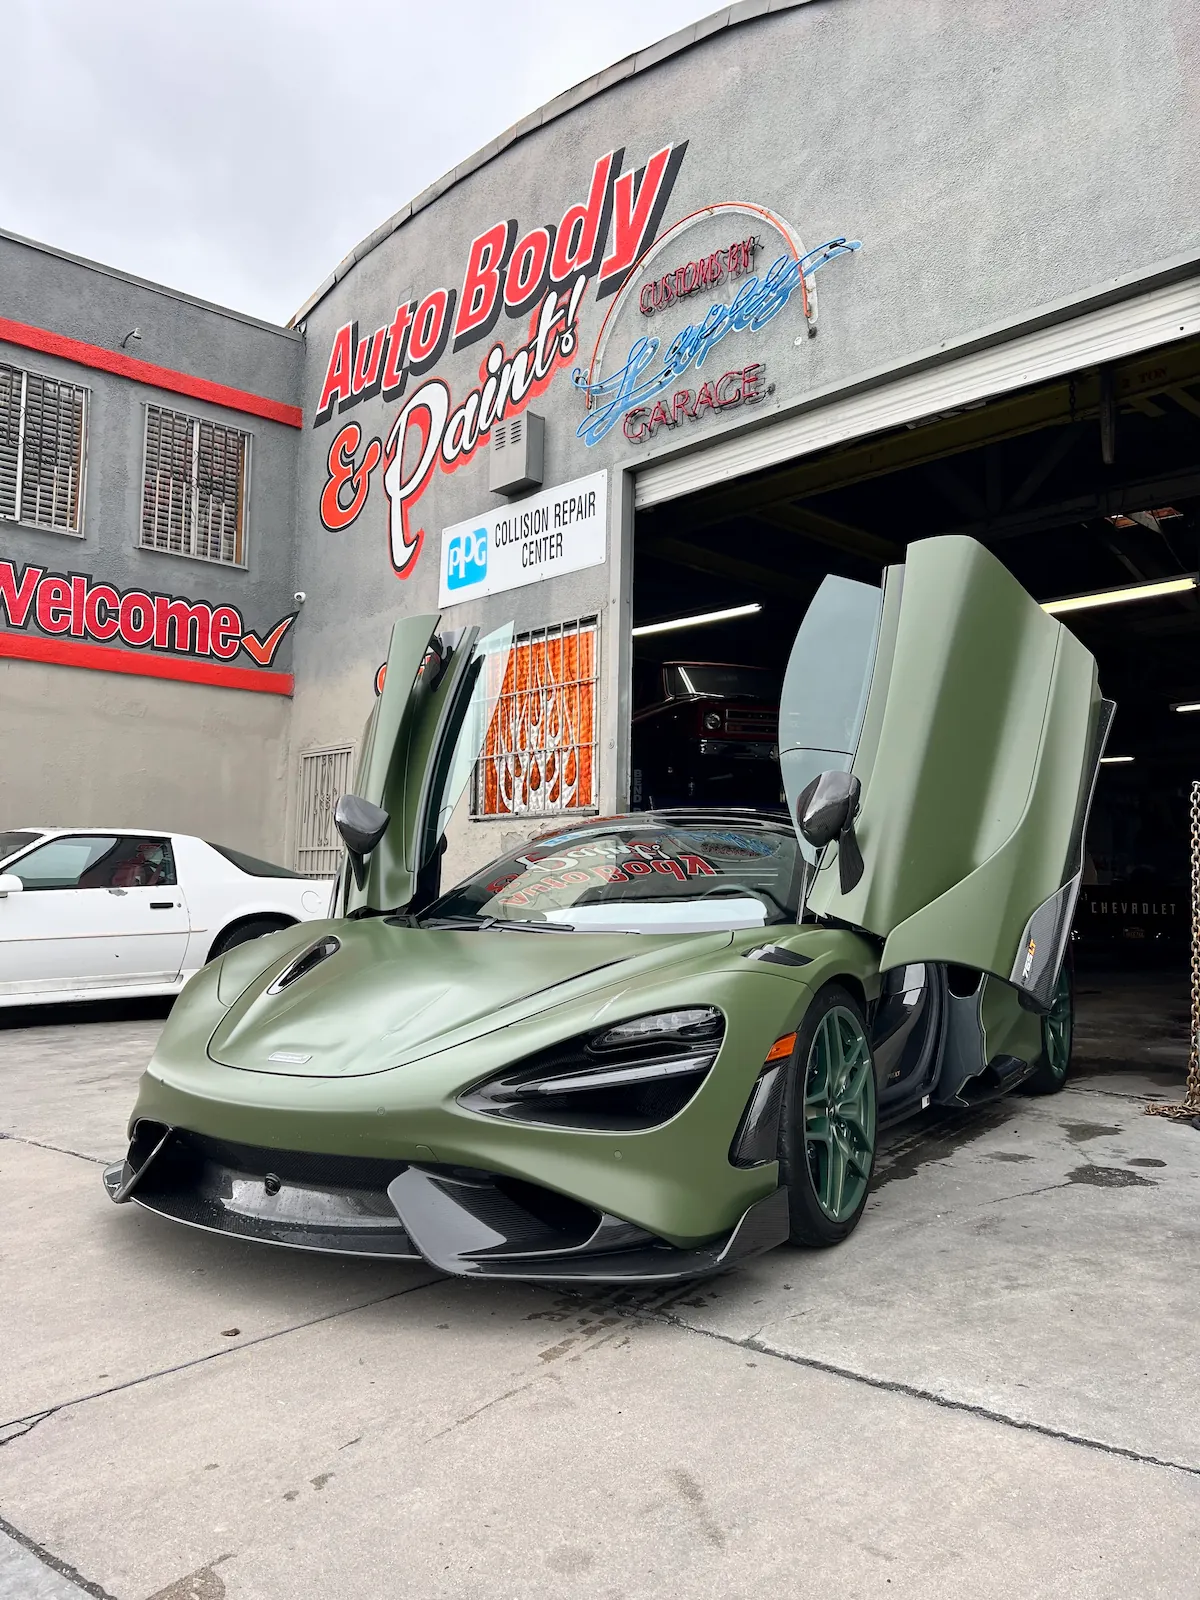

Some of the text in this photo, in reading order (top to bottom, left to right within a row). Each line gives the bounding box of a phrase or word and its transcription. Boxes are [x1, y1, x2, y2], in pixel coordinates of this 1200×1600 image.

[315, 141, 685, 423] Auto Body
[638, 235, 761, 317] CUSTOMS BY
[319, 274, 587, 577] & Paint!
[622, 362, 767, 444] GARAGE
[495, 491, 596, 548] COLLISION REPAIR
[521, 532, 563, 568] CENTER
[1090, 900, 1177, 916] CHEVROLET
